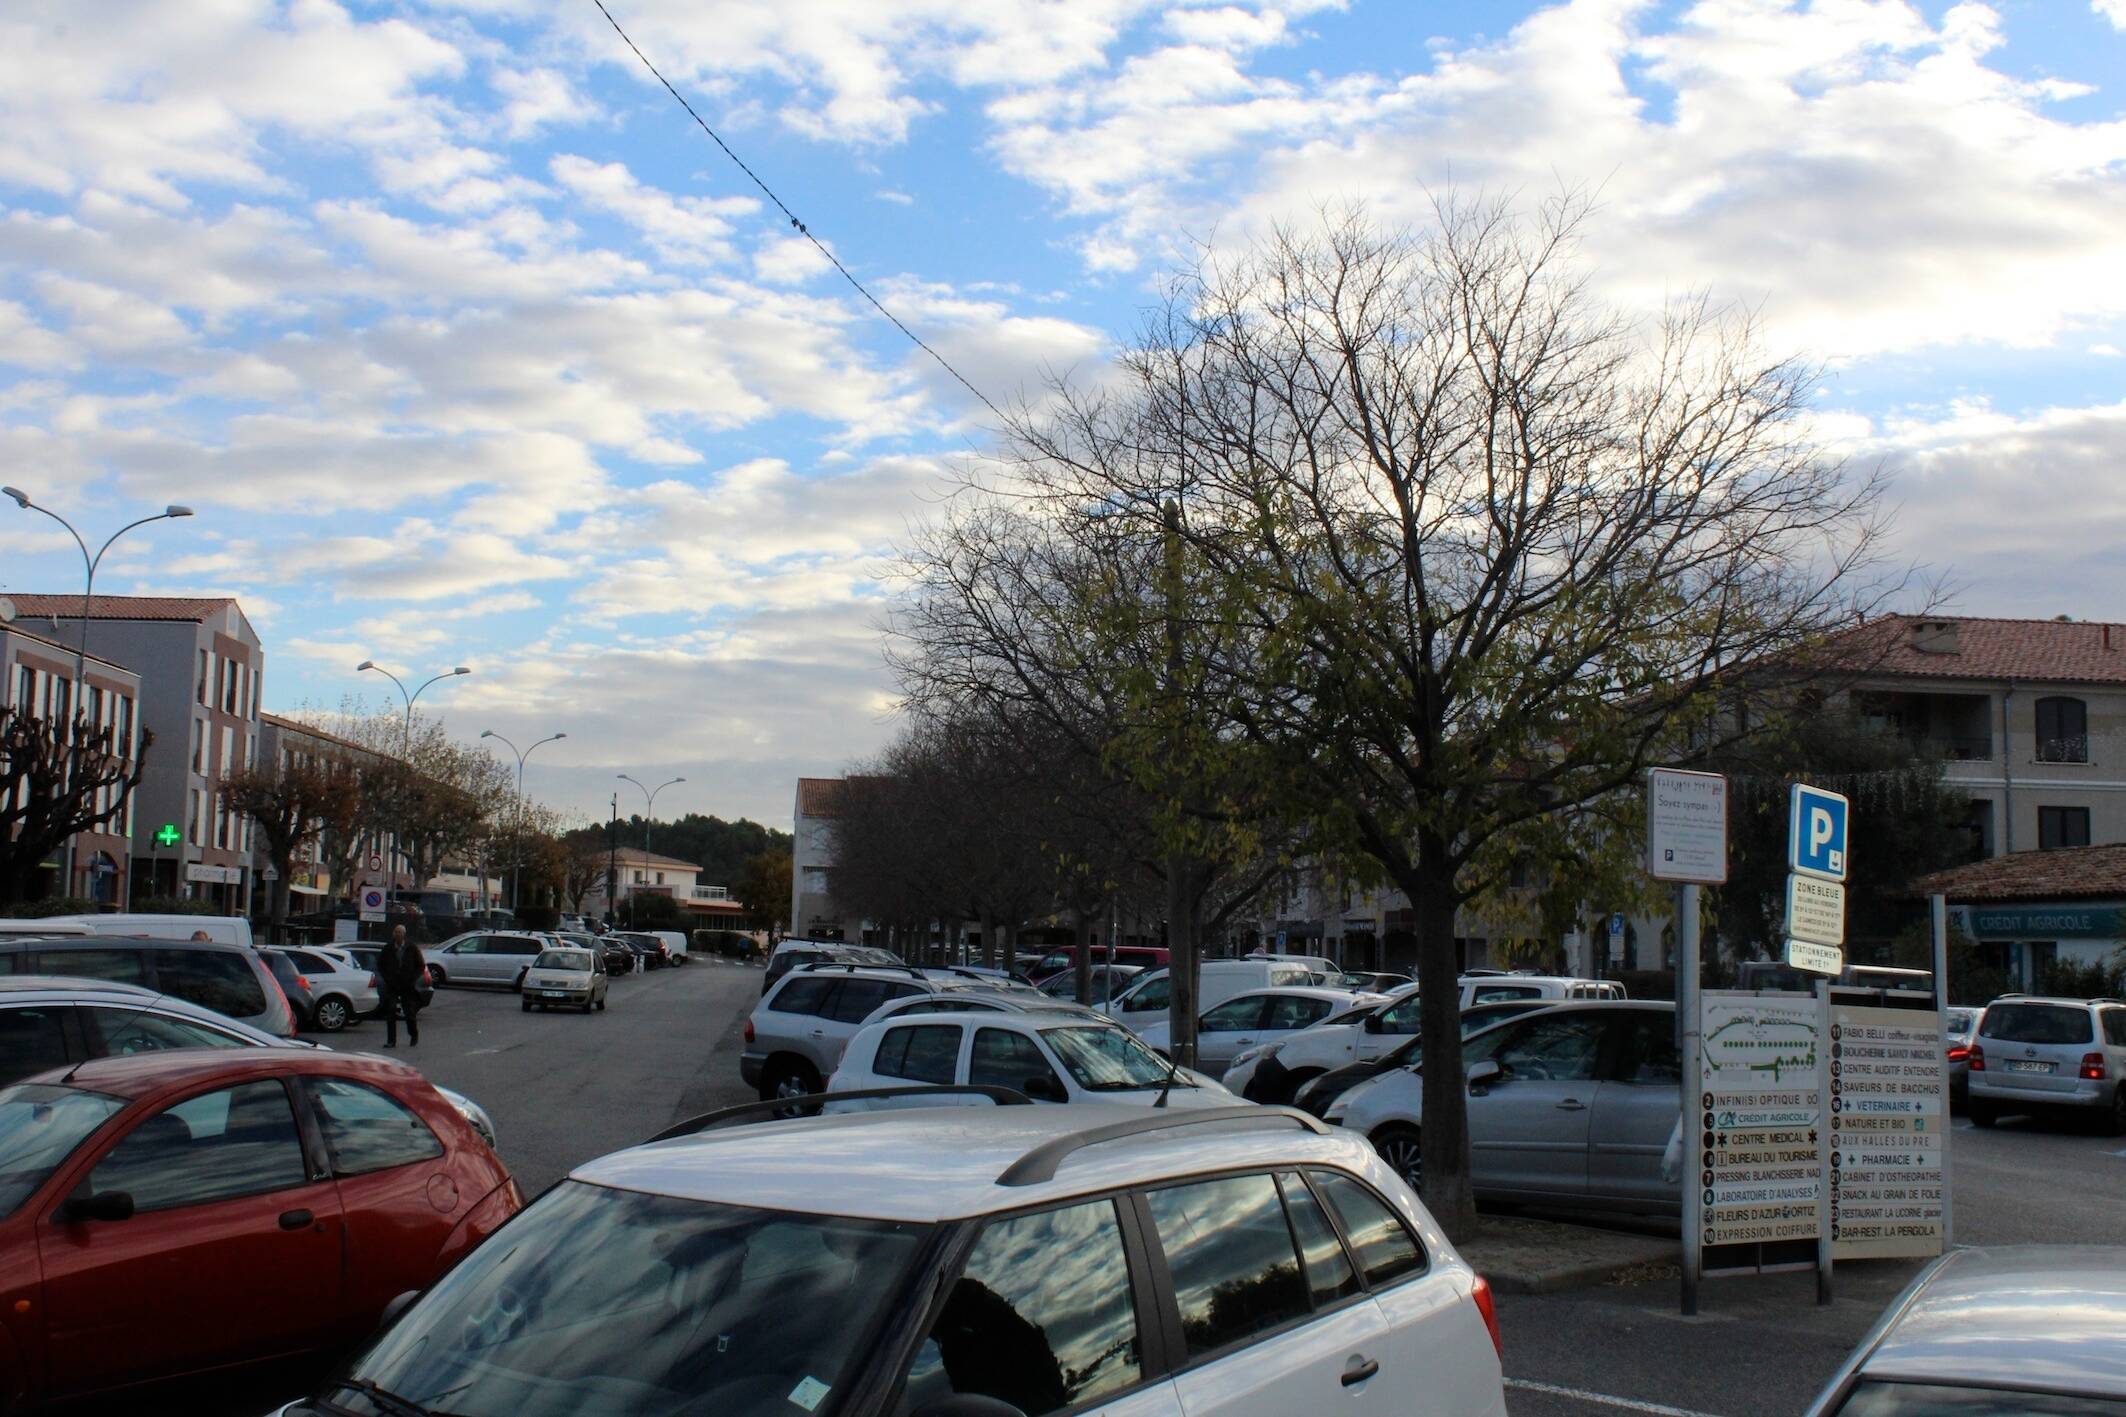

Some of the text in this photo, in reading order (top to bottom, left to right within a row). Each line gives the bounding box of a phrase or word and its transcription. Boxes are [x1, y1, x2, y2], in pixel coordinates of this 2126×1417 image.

[1810, 806, 1833, 858] P
[1797, 882, 1839, 899] ZONE BLEUE
[2027, 915, 2092, 930] AGRICOLE
[1791, 944, 1841, 959] STATIONNEMENT
[1843, 1047, 1886, 1058] BOUCHERIE
[1843, 1064, 1872, 1074] CENTRE
[1903, 1066, 1939, 1077] ENTENDRE
[1843, 1082, 1882, 1093] SAVEURS
[1886, 1083, 1897, 1093] DE
[1901, 1084, 1940, 1095] BACCHUS
[1760, 1095, 1800, 1105] OPTIQUE
[1770, 1113, 1809, 1121] AGRICOLE
[1845, 1119, 1878, 1129] NATURE
[1880, 1119, 1890, 1129] ET
[1891, 1119, 1906, 1129] BIO
[1731, 1132, 1804, 1145] CENTRE MEDICAL
[1842, 1136, 1858, 1145] AUX
[1862, 1136, 1895, 1146] HALLES
[1899, 1136, 1910, 1146] DU
[1728, 1152, 1762, 1164] BUREAU
[1763, 1152, 1776, 1163] DU
[1778, 1150, 1818, 1162] TOURISME
[1862, 1155, 1911, 1165] PHARMACIE
[1716, 1171, 1751, 1182] PRESSING
[1753, 1169, 1804, 1181] BLANCHISSERIE
[1842, 1172, 1875, 1182] CABINET
[1716, 1190, 1767, 1202] LABORATOIRE
[1770, 1187, 1812, 1200] D'ANALYSES
[1842, 1190, 1867, 1200] SNACK
[1870, 1190, 1880, 1199] AU
[1883, 1190, 1906, 1199] GRAIN
[1908, 1190, 1918, 1199] DE
[1921, 1189, 1941, 1199] FOLIE
[1716, 1206, 1816, 1222] FLEURS D'AZUR ORTIZ
[1841, 1208, 1882, 1219] RESTAURANT
[1885, 1208, 1893, 1218] LA
[1717, 1227, 1772, 1241] EXPRESSION
[1776, 1223, 1817, 1237] COIFFURE
[1885, 1226, 1896, 1236] LA
[1897, 1226, 1936, 1236] PERGOLA
